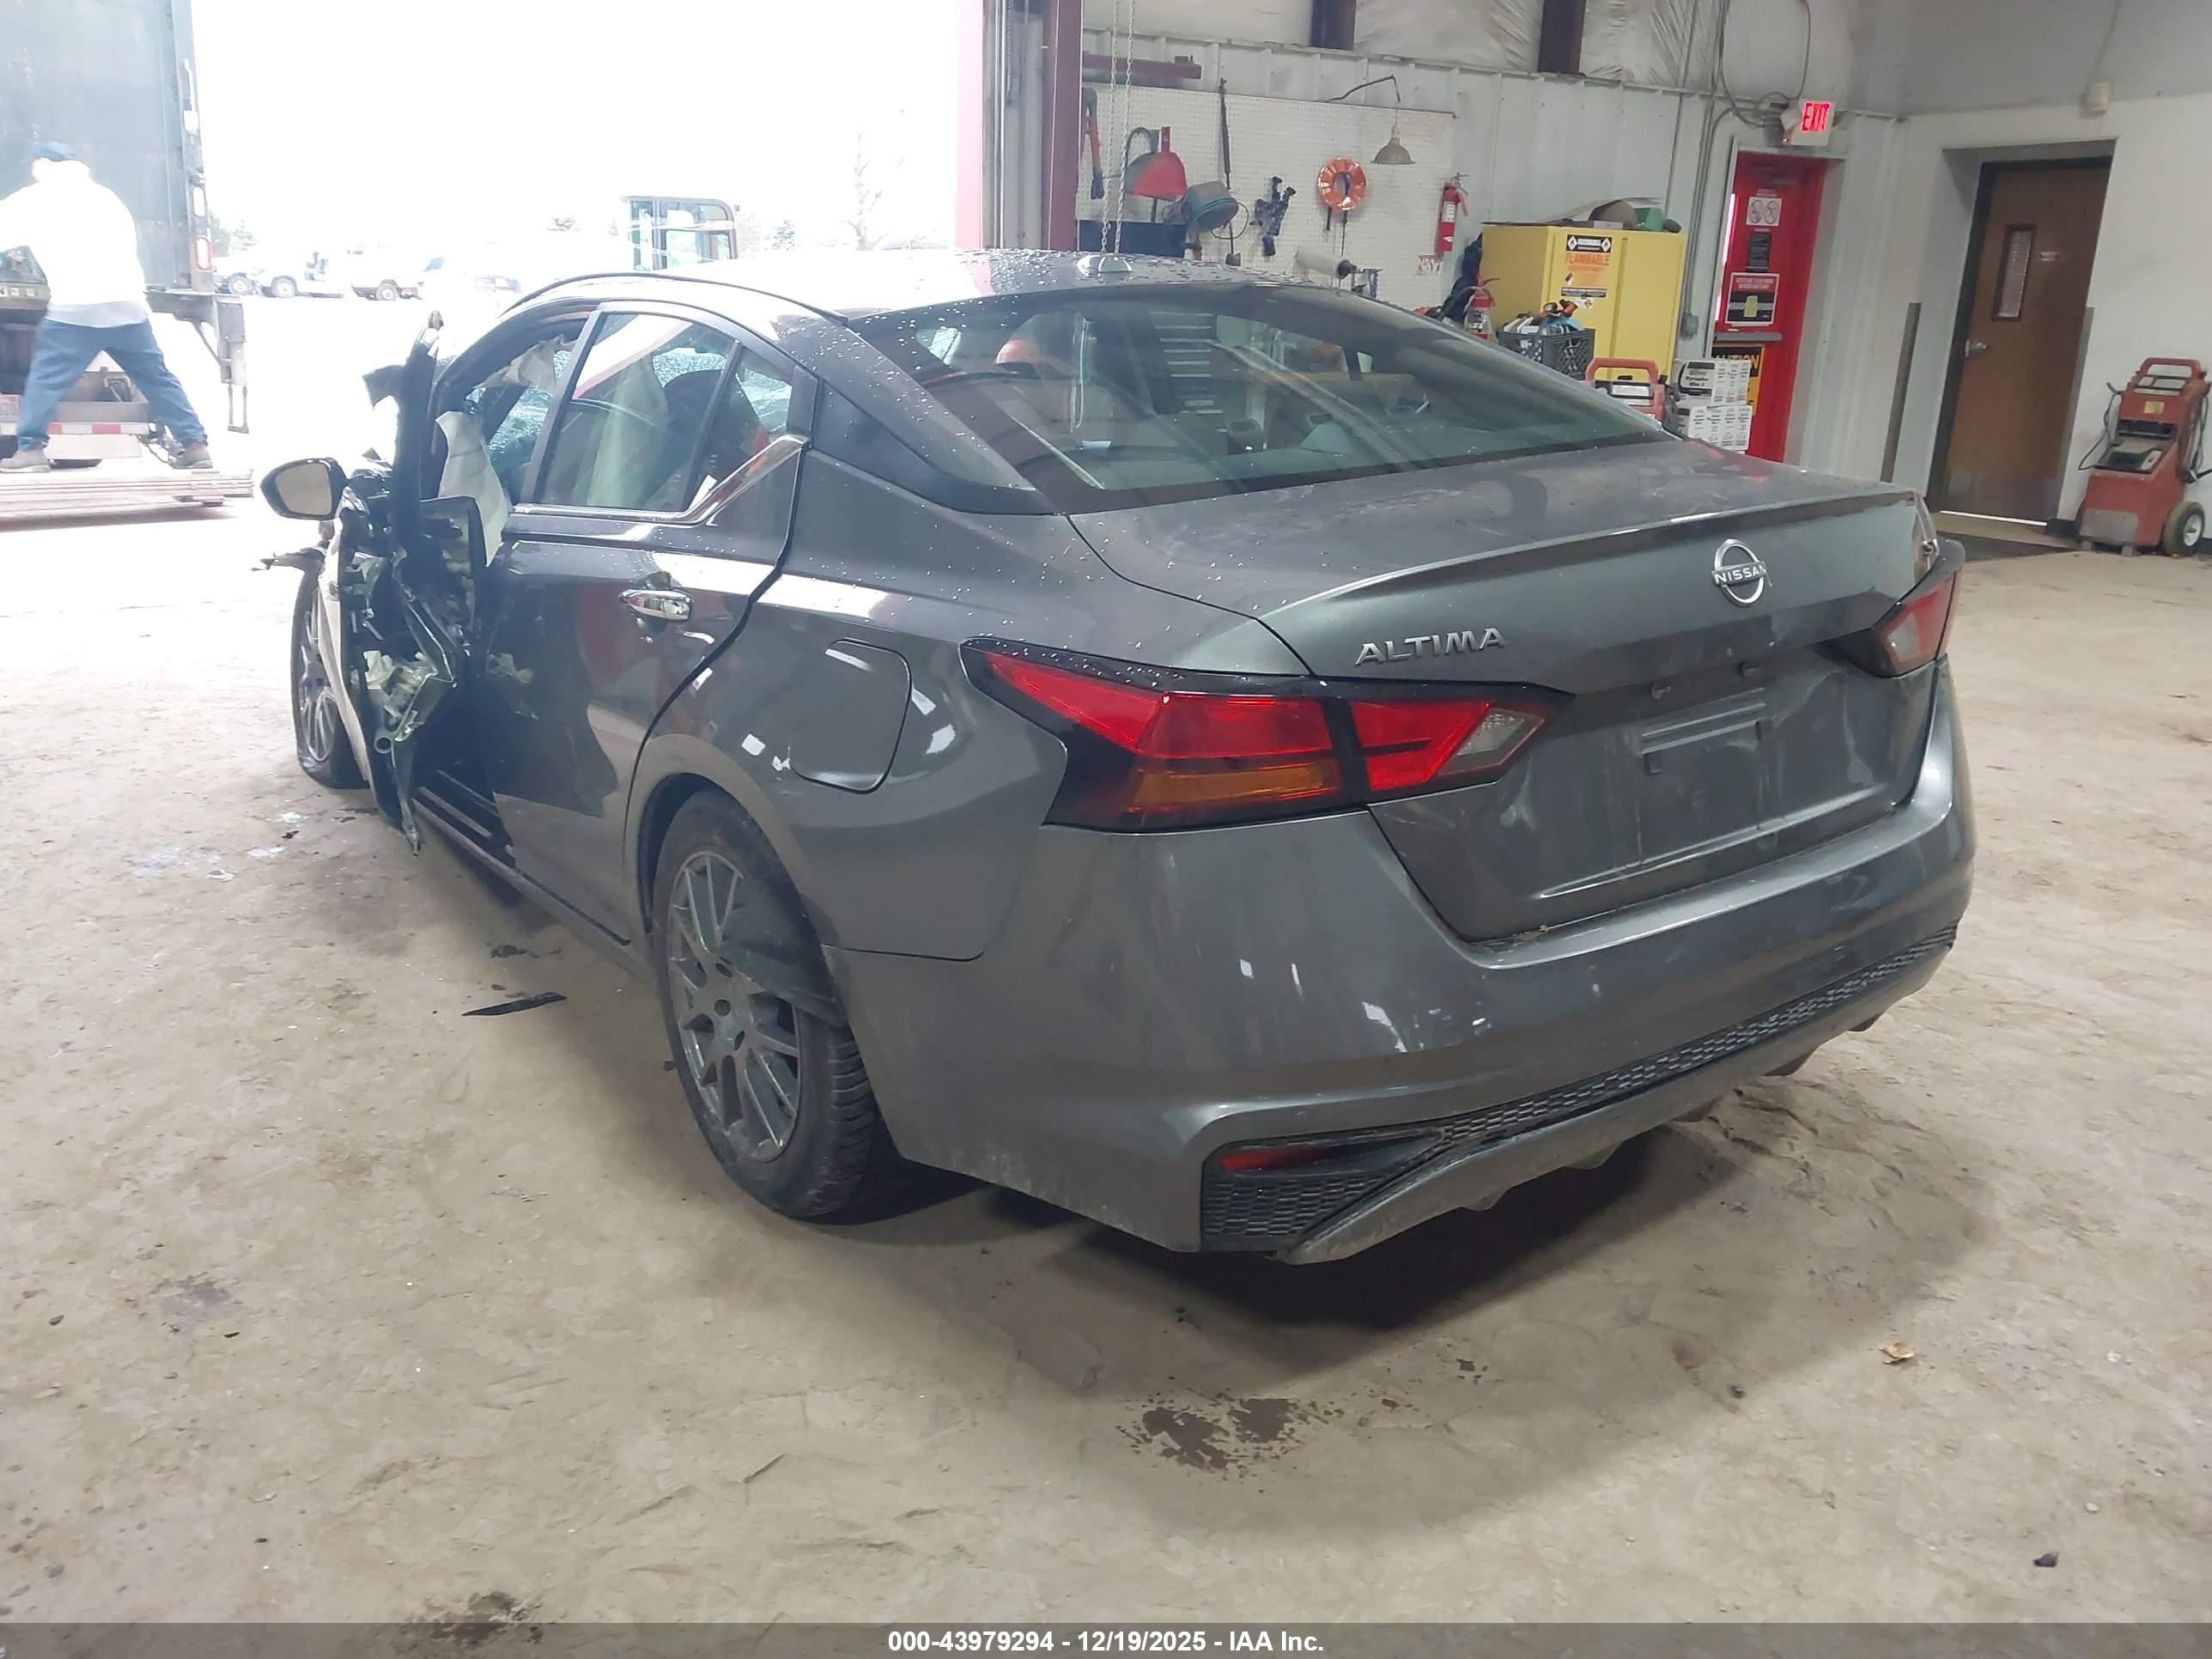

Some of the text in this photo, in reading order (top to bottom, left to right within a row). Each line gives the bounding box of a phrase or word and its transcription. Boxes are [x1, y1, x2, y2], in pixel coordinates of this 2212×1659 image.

[1801, 101, 1831, 131] EXIT
[1714, 565, 1766, 584] NISSAN
[1354, 627, 1505, 665] ALTIMA
